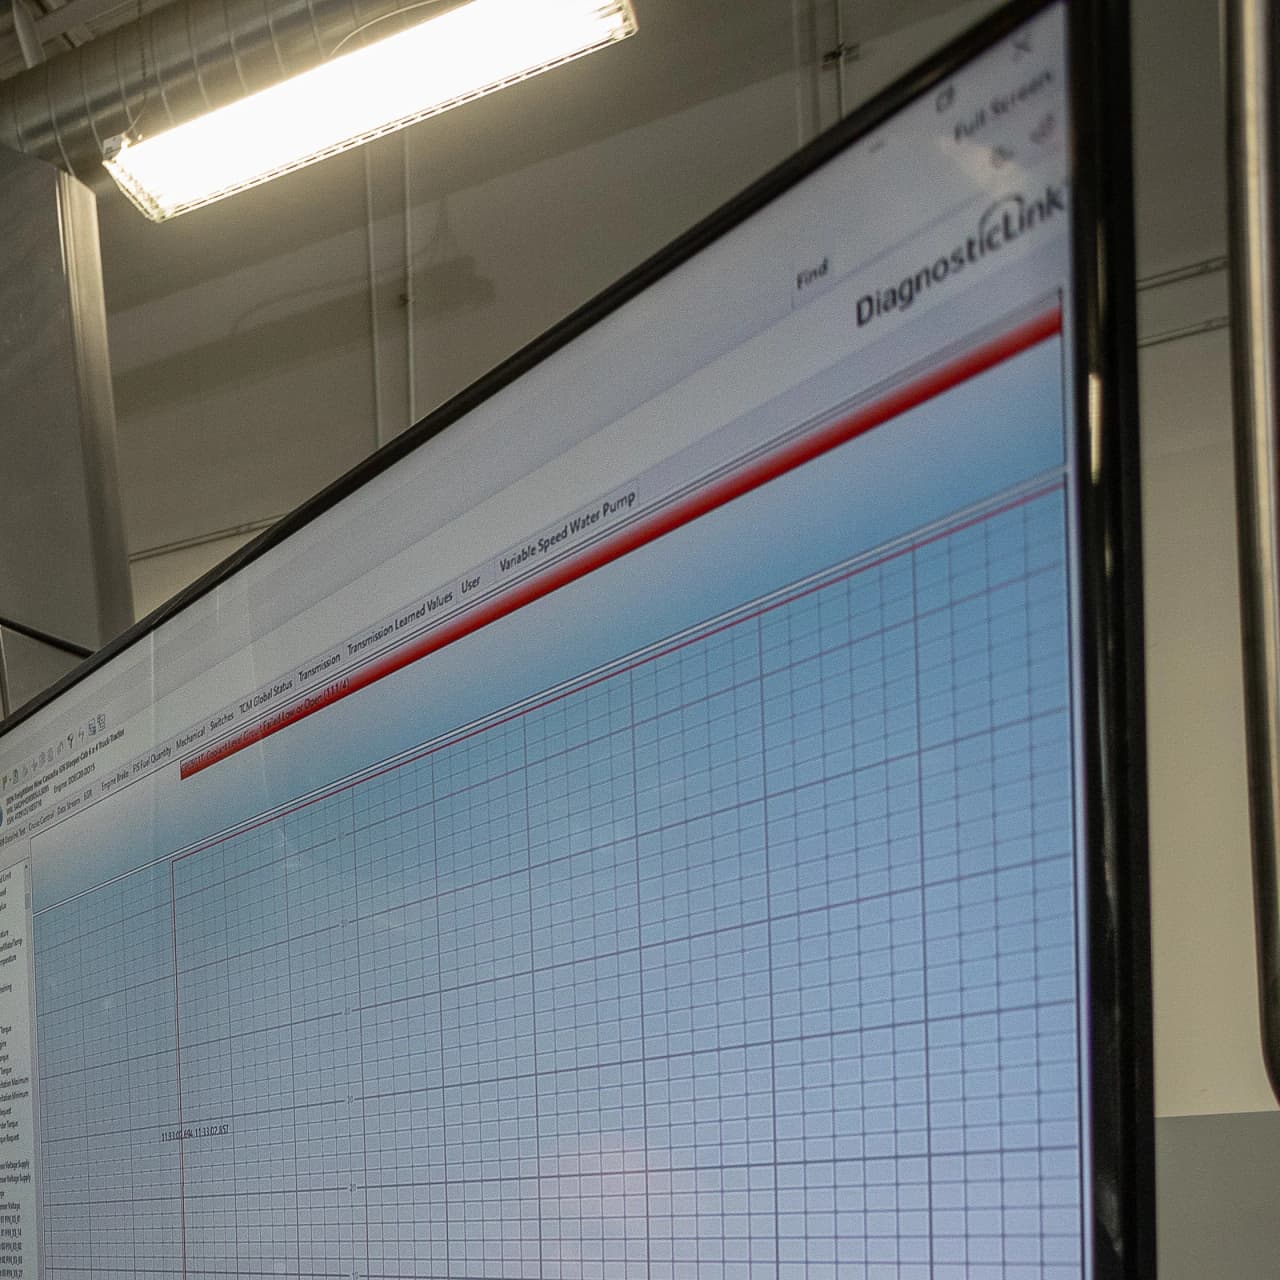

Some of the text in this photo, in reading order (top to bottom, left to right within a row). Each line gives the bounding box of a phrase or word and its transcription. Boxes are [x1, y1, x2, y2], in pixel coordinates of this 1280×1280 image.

[856, 184, 1066, 328] DiagnosticLink
[795, 258, 829, 290] Find
[499, 489, 636, 572] Variable Speed Water Pump
[460, 575, 480, 594] User
[347, 588, 452, 654] Transmission Learned Values
[298, 654, 340, 682] Transmission
[239, 677, 292, 715] TCM Global Status
[304, 694, 322, 712] Open
[210, 711, 233, 730] Switches
[175, 727, 205, 748] Mechanical
[140, 746, 171, 769] Fuel Quantity
[101, 777, 115, 793] Engine
